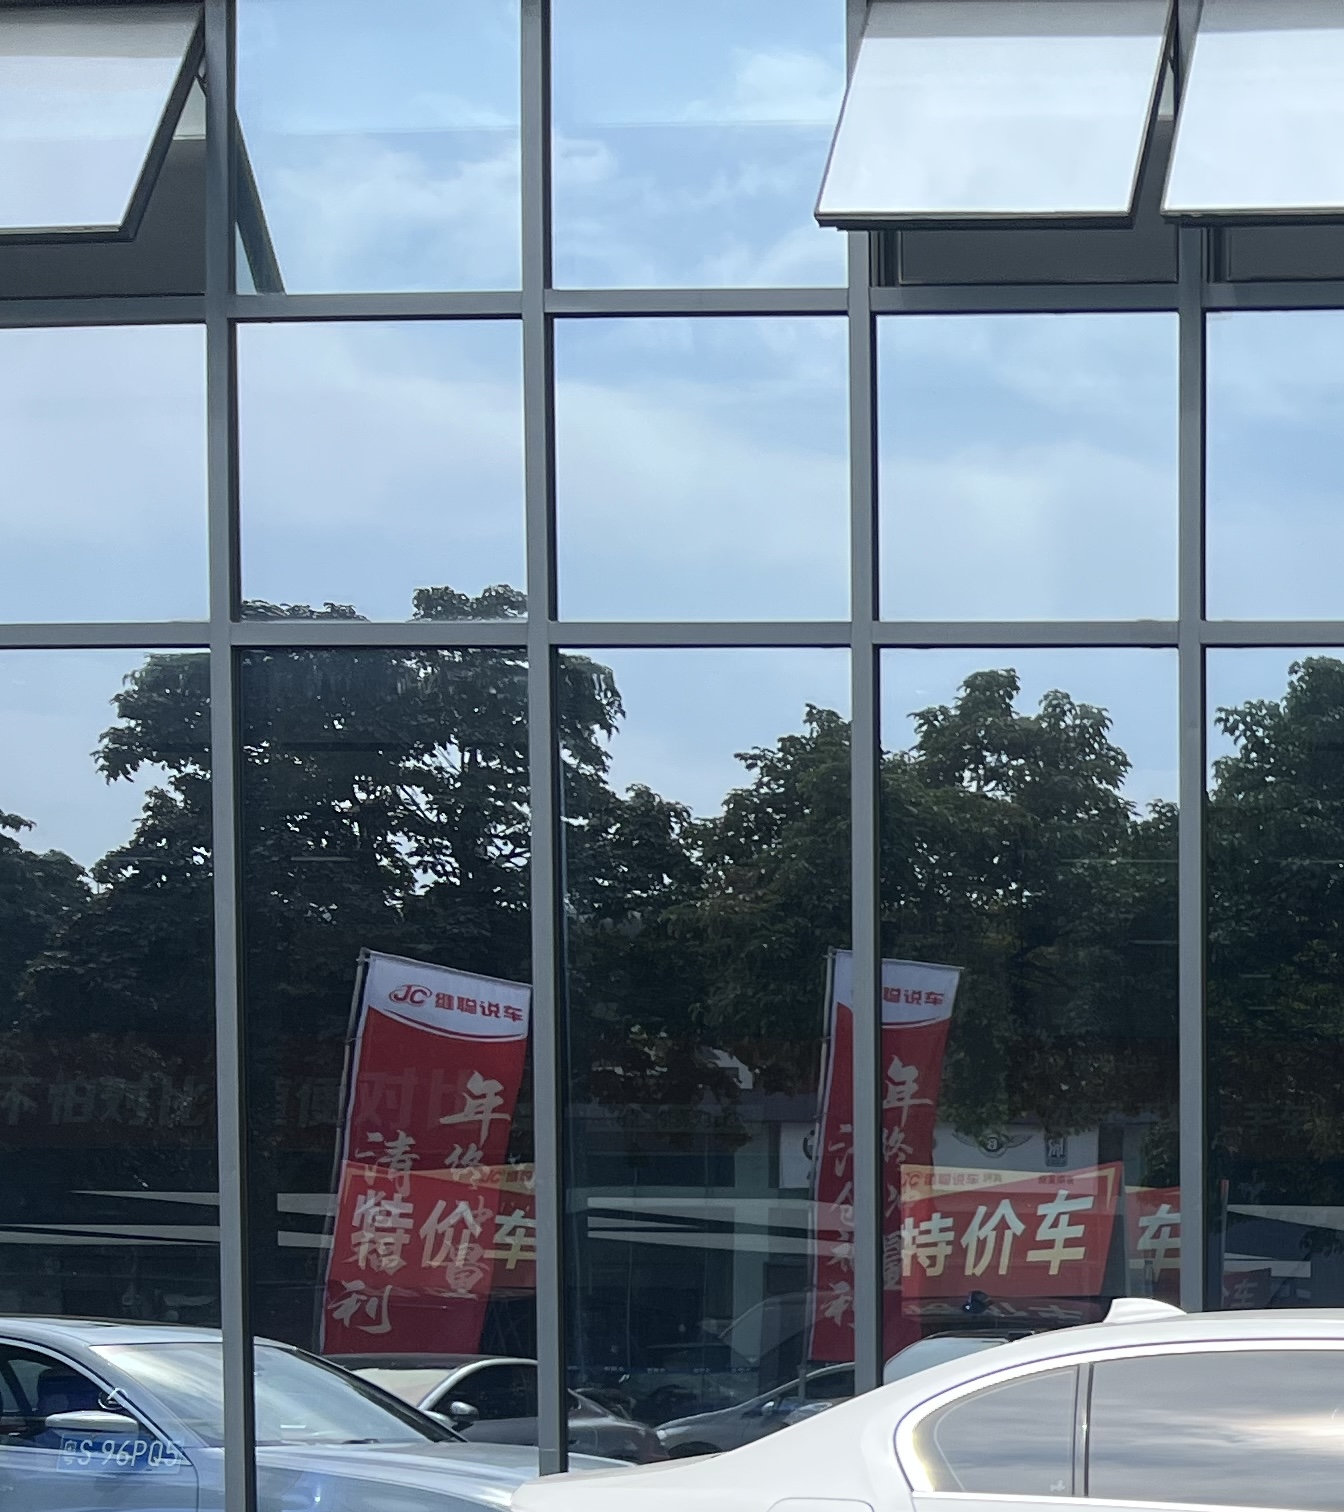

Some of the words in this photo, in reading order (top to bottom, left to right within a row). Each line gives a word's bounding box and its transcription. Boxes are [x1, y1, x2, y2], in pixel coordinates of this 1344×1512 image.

[389, 984, 433, 1007] JC
[900, 1189, 1094, 1277] 特价车
